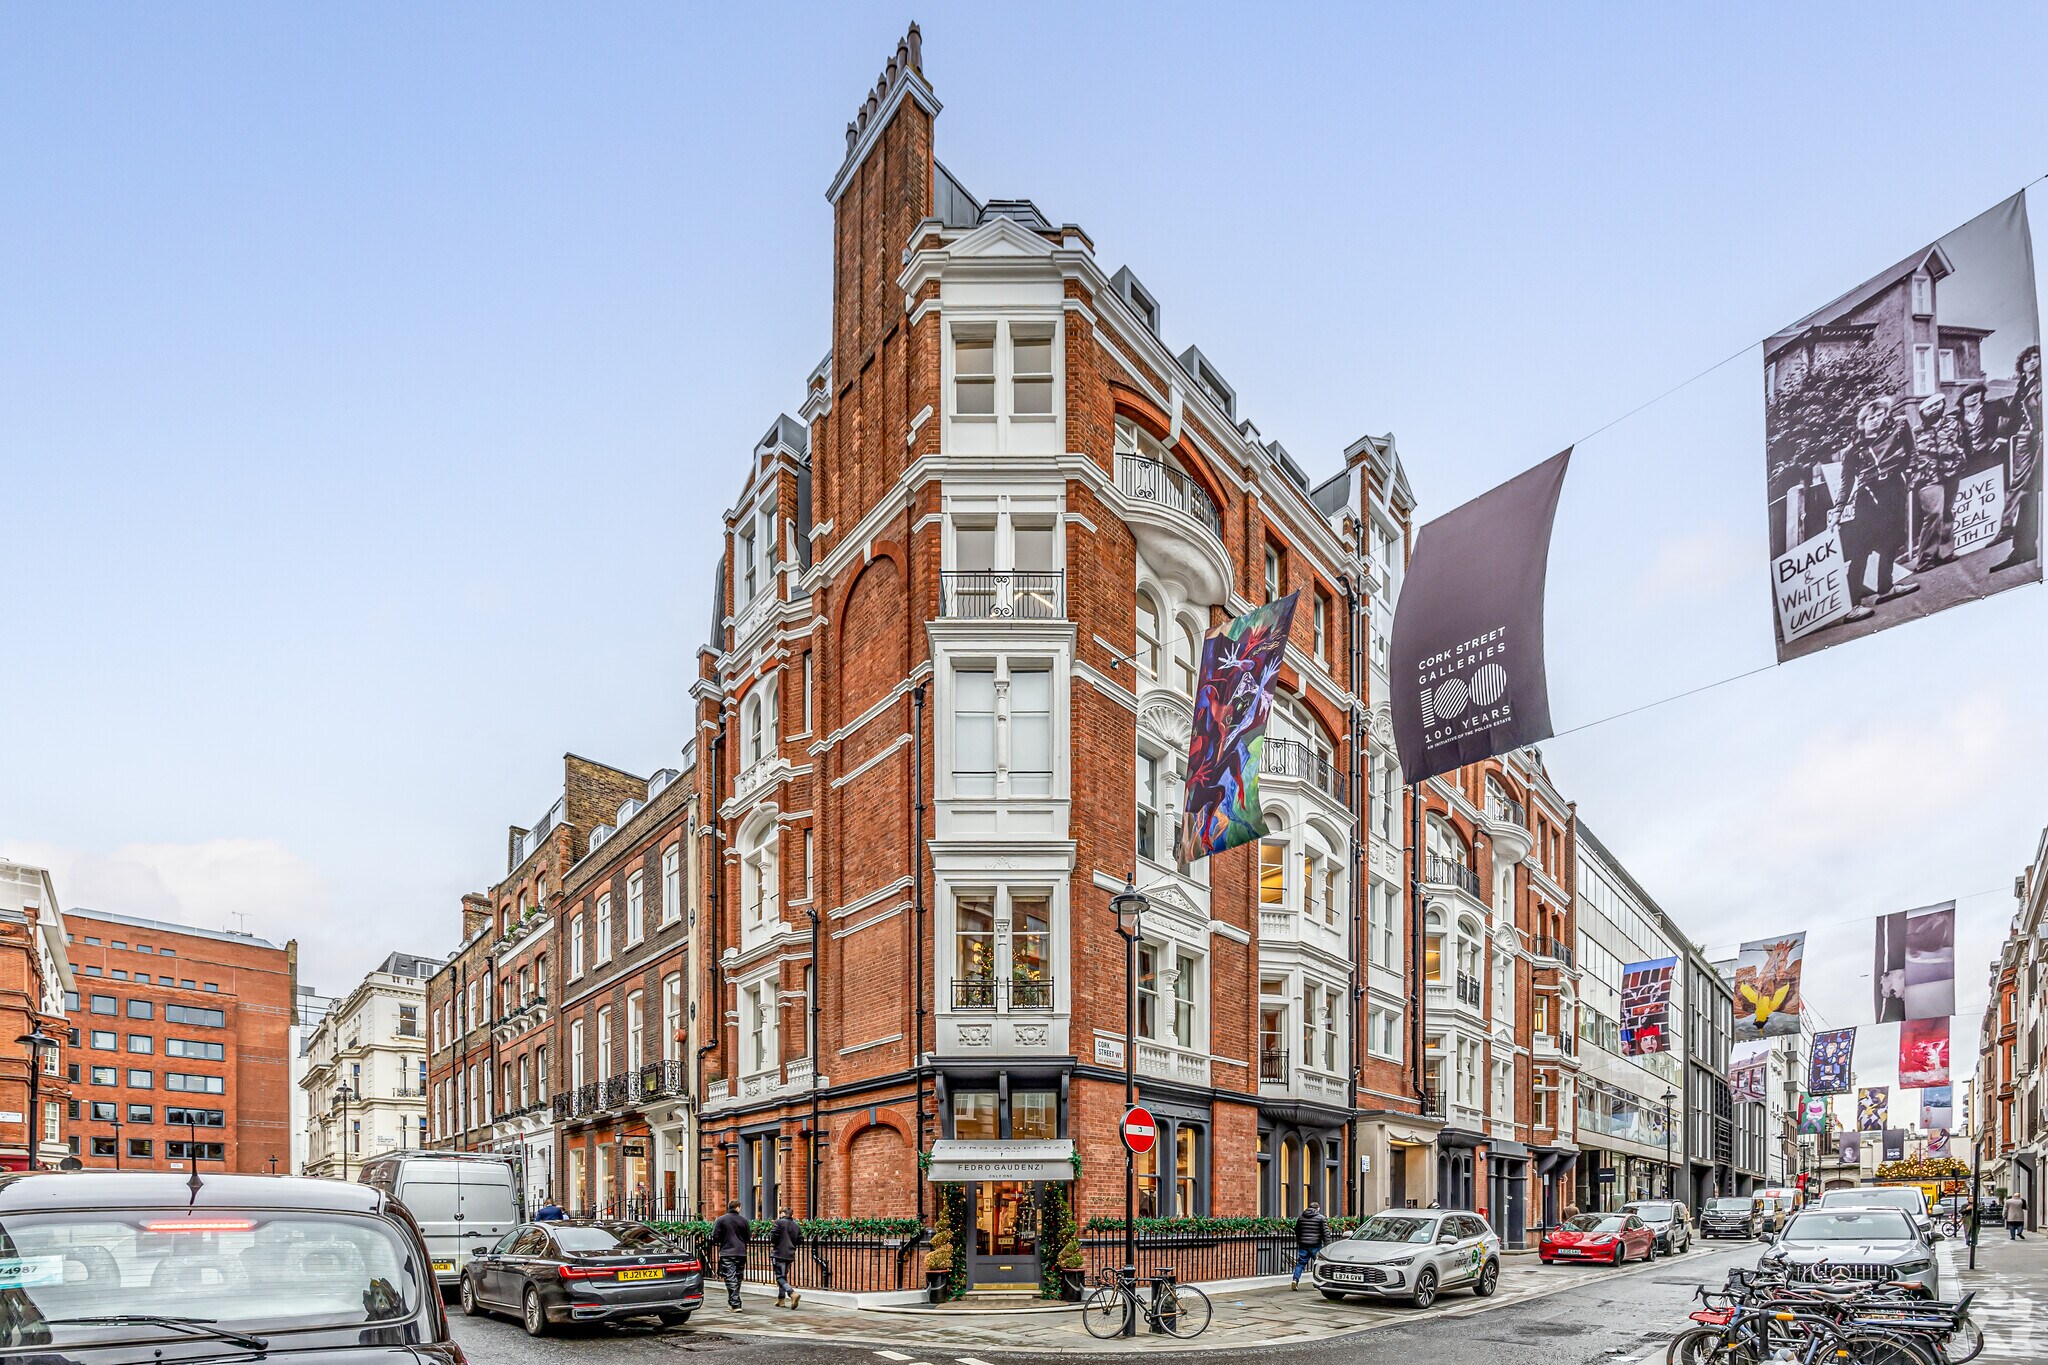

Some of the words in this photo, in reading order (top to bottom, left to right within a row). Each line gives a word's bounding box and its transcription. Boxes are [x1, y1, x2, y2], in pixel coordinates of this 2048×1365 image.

[1955, 478, 1995, 502] OU'VE
[1979, 492, 1996, 506] TO
[1984, 520, 1998, 534] IT
[1779, 539, 1838, 583] BLACK
[1781, 569, 1840, 613] WHITE
[1804, 570, 1816, 585] &
[1790, 590, 1842, 630] UNITE
[1418, 649, 1451, 670] CORK
[1456, 626, 1506, 655] STREET
[1418, 642, 1506, 685] GALLERIES
[1424, 726, 1452, 744] 100
[1462, 705, 1511, 729] YEARS
[1434, 736, 1457, 748] INITIATIVE
[1493, 716, 1512, 727] ESTATE
[1098, 1041, 1110, 1049] CORK
[1098, 1049, 1114, 1057] STREET
[623, 1271, 641, 1279] RJ21
